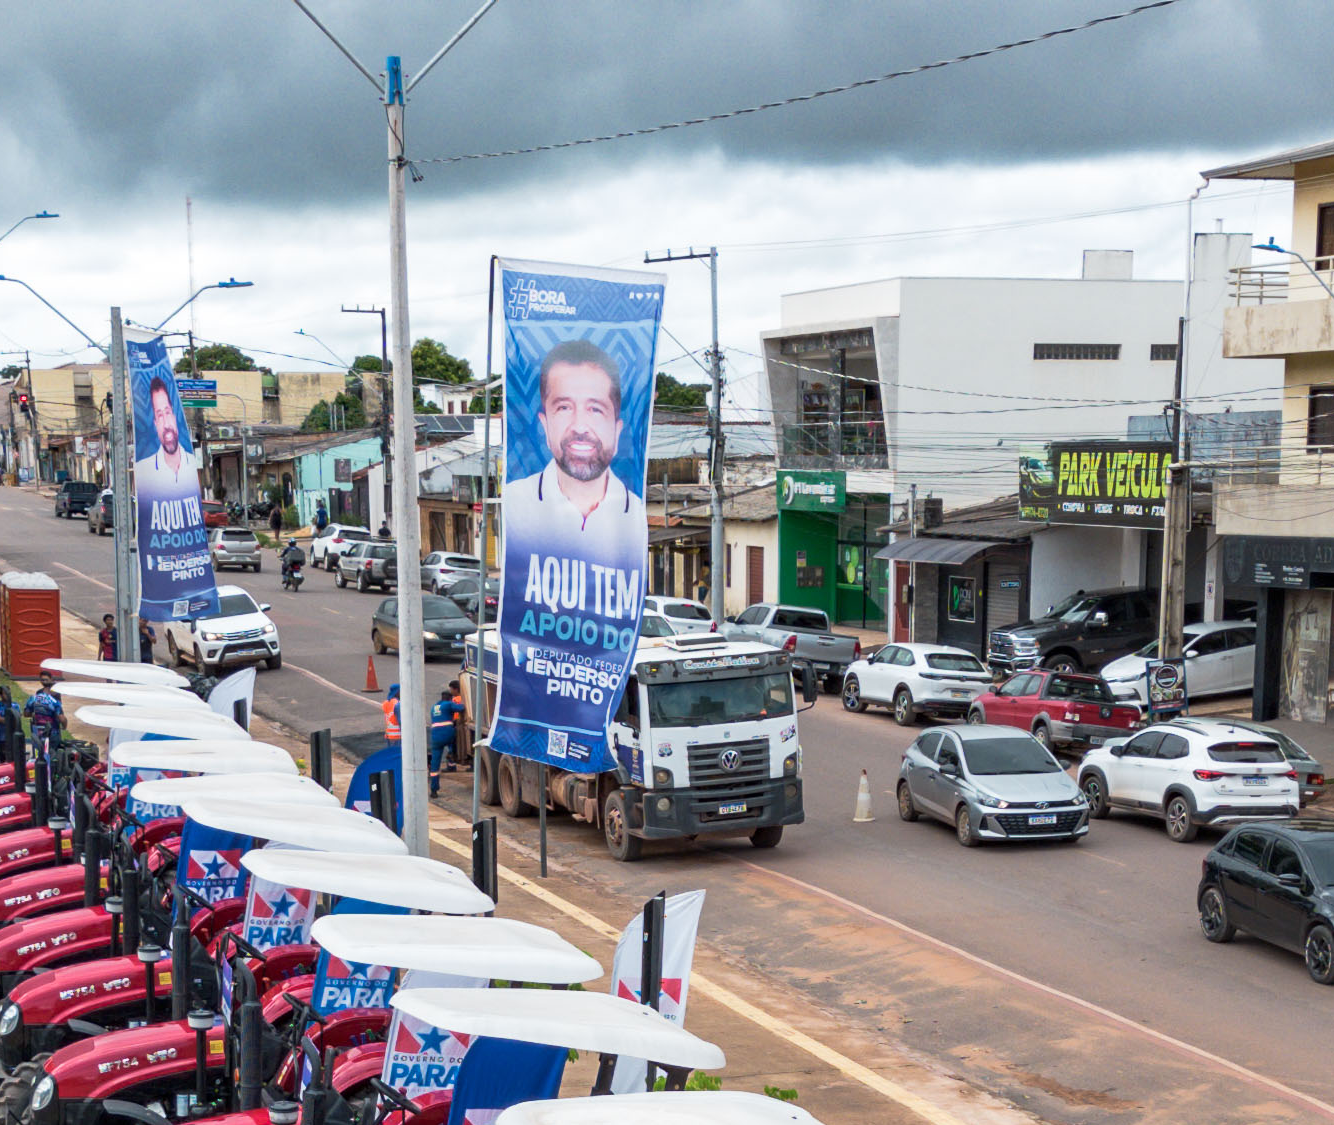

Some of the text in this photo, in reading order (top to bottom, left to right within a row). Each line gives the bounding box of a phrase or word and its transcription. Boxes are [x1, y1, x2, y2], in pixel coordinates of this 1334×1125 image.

[528, 302, 576, 316] PROSPERAR
[1058, 450, 1172, 498] PARK VEÍCULO
[151, 500, 185, 533] AQUI
[150, 533, 193, 548] APOIO
[147, 554, 211, 571] HENDERSO
[172, 567, 205, 581] PINTO
[524, 553, 639, 620] AQUI TEM
[519, 609, 635, 653] APOIO DO
[511, 643, 620, 691] HENDERSO
[534, 648, 623, 673] DEPUTADO FEDER
[547, 678, 604, 705] PINTO
[250, 918, 292, 926] GOVERNO
[325, 979, 371, 987] GOVERNO
[393, 1054, 444, 1063] GOVERNO
